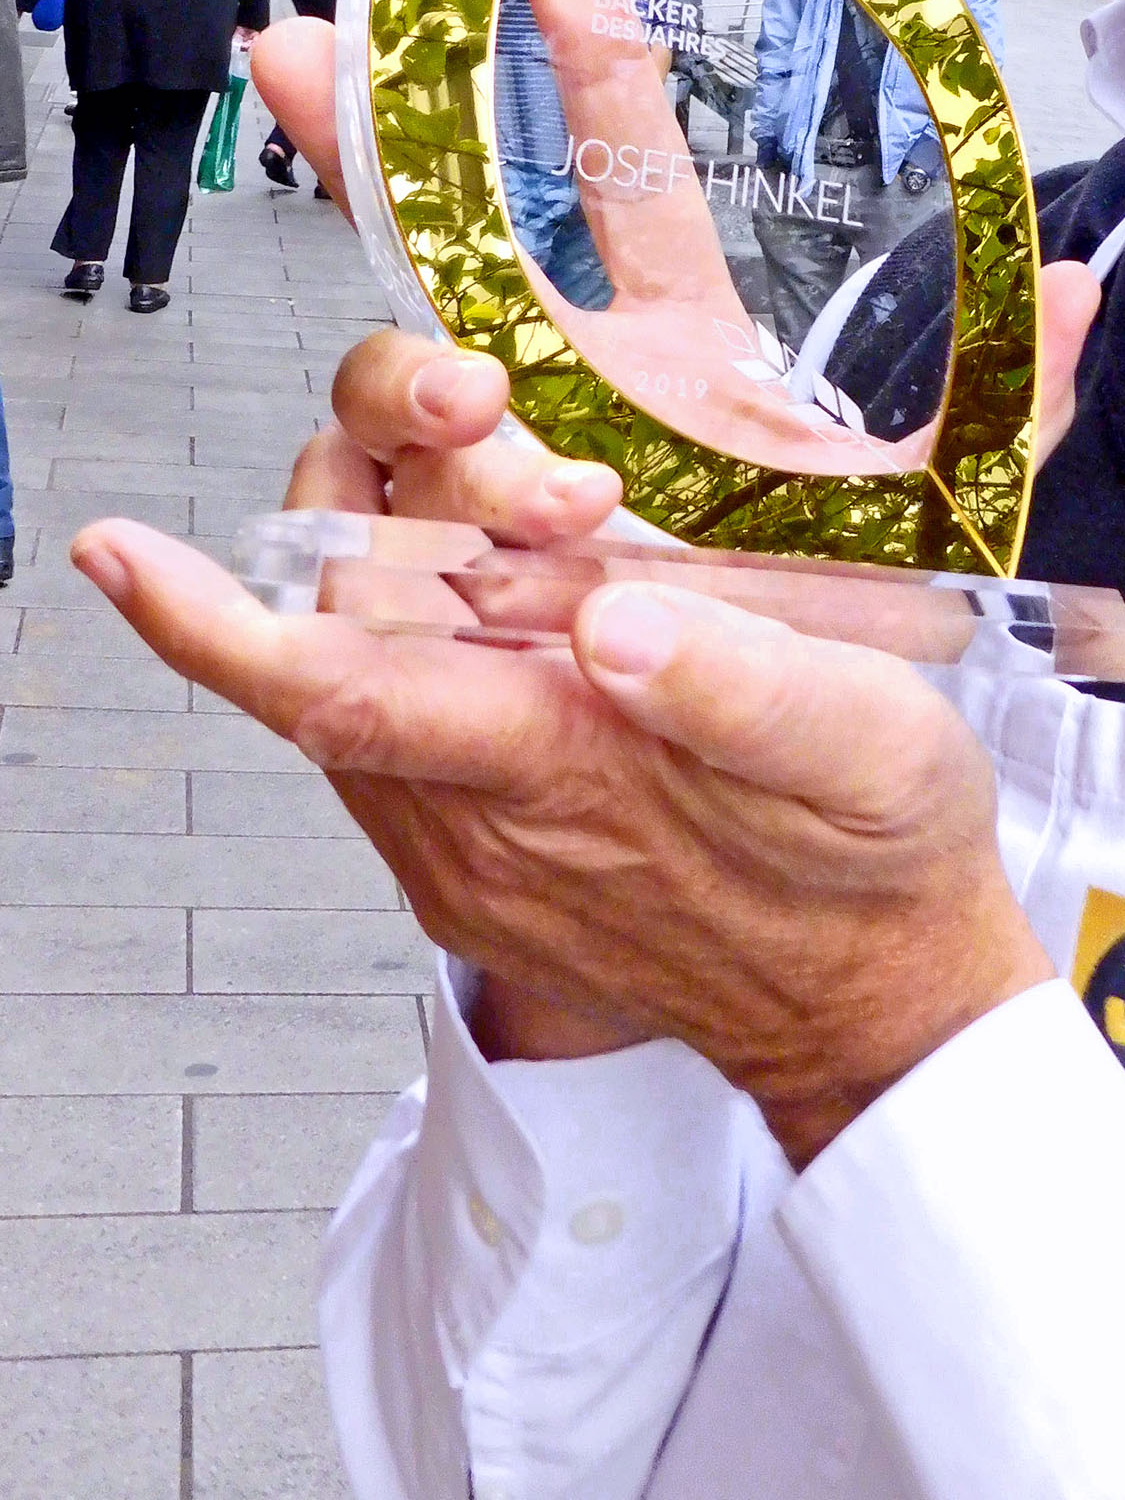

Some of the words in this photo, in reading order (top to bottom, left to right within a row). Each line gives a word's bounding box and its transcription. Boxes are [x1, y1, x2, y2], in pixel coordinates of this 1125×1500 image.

[591, 13, 635, 41] DES
[640, 23, 727, 61] JAHRES
[551, 135, 695, 194] JOSEF
[706, 160, 864, 228] HINKEL
[635, 370, 708, 400] 2019
